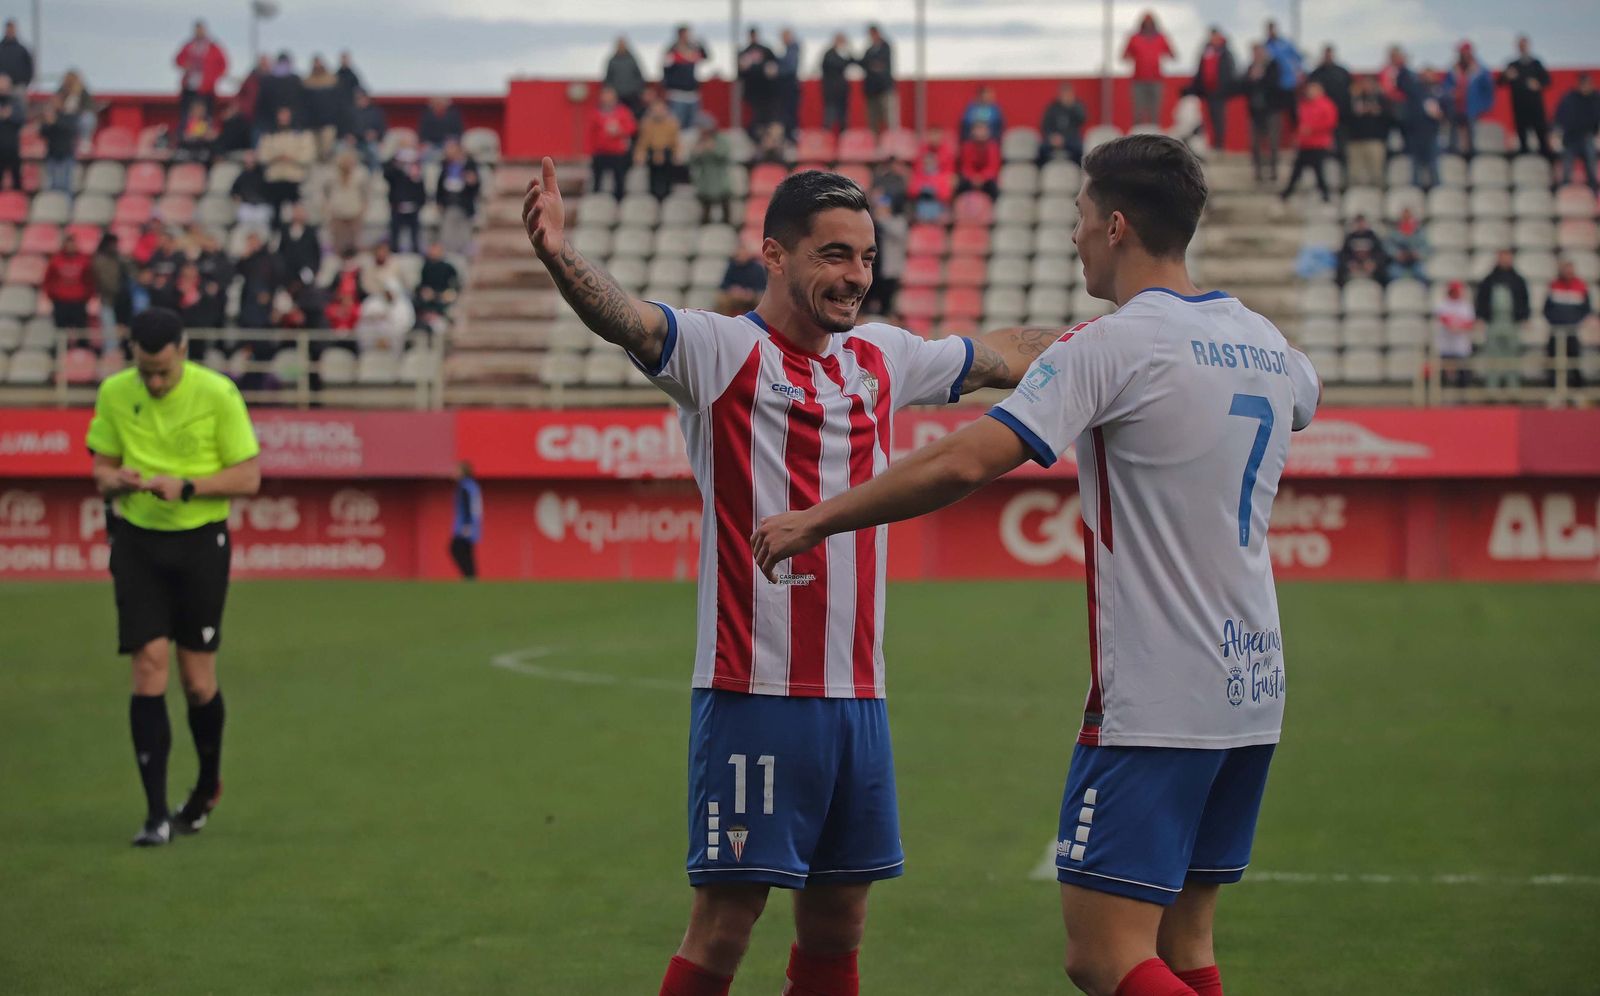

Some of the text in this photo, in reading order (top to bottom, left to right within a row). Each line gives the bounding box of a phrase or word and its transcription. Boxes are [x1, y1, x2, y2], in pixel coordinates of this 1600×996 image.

[536, 412, 684, 473] capel
[1228, 393, 1275, 547] 7
[1488, 493, 1600, 561] AL
[727, 753, 775, 815] 11
